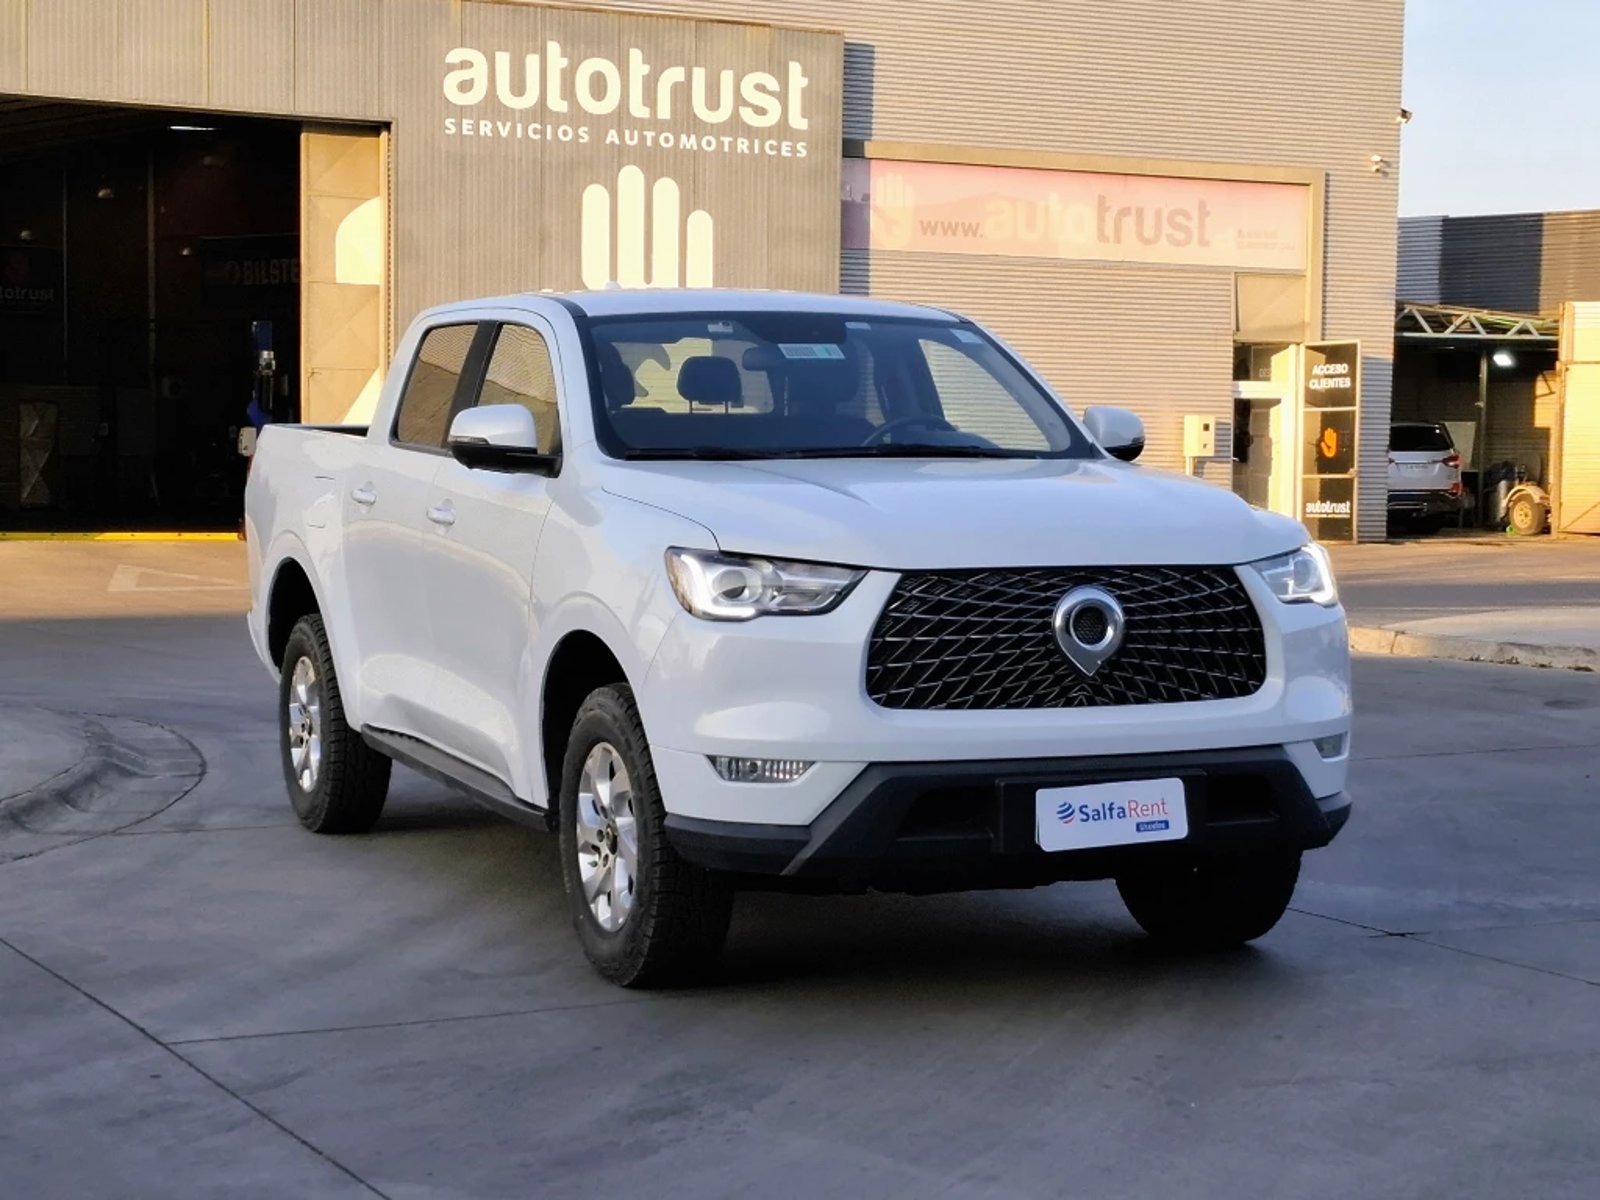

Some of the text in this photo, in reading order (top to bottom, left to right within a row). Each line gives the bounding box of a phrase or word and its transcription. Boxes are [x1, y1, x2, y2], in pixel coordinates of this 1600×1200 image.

[443, 40, 808, 130] autotrust
[445, 118, 809, 159] SERVICIOS AUTOMOTRICES
[1314, 363, 1348, 375] ACCESO
[1310, 378, 1350, 389] CLIENTES
[1305, 500, 1351, 513] autotrust
[1079, 798, 1168, 822] SalfaRent
